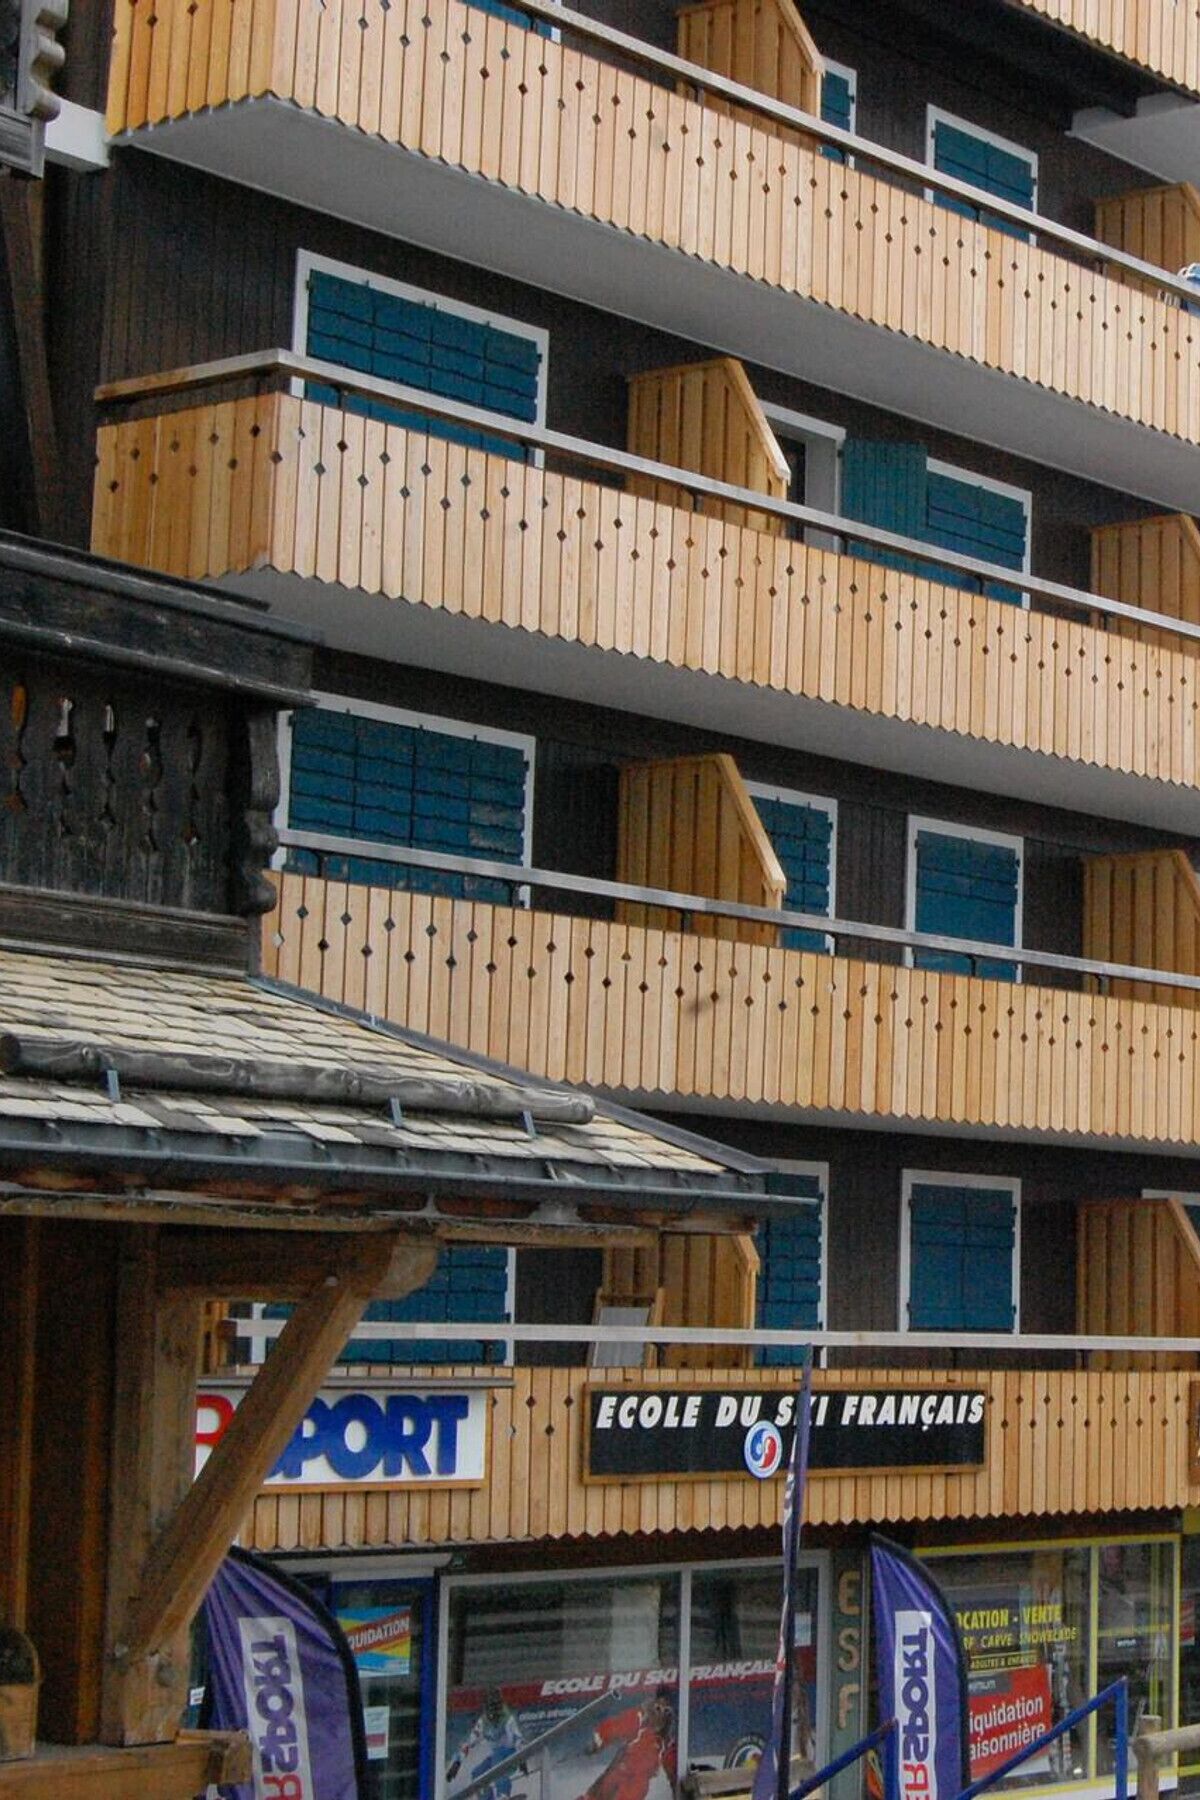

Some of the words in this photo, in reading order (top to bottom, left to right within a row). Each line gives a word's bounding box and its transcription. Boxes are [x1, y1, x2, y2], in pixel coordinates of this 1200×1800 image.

[596, 1395, 702, 1428] ECOLE
[715, 1395, 762, 1427] DU
[841, 1395, 985, 1432] FRANÇAIS
[348, 1617, 410, 1650] QUIDATION
[956, 1609, 1009, 1631] CATION
[1022, 1604, 1062, 1624] VENTE
[540, 1676, 605, 1697] ECOLE
[608, 1672, 640, 1690] DU
[644, 1668, 678, 1686] SKI
[969, 1696, 1044, 1736] iquidation
[969, 1721, 1046, 1761] aisonnière
